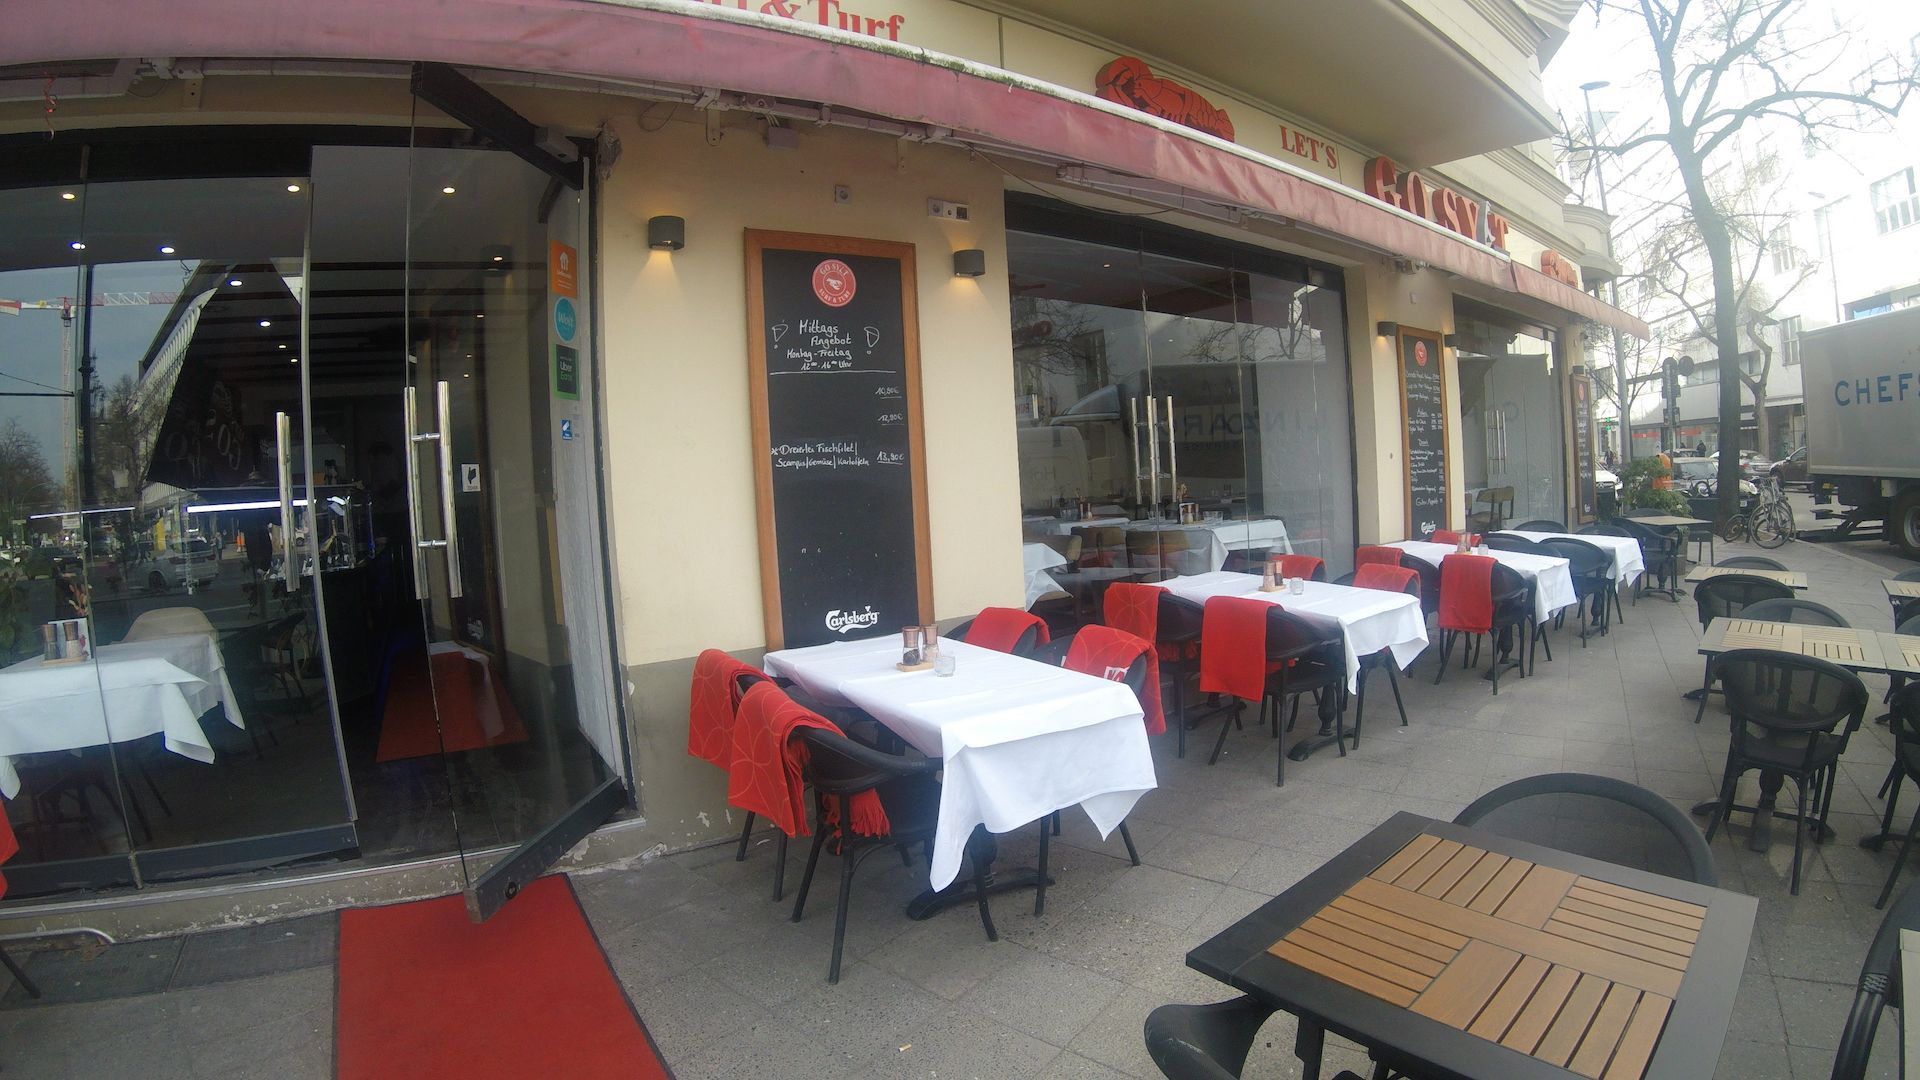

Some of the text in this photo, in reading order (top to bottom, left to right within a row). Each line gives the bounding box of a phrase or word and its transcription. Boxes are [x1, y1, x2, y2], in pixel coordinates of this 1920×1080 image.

[806, 0, 906, 42] Turf
[1279, 124, 1337, 169] LET'S
[1364, 155, 1428, 220] GO
[799, 319, 839, 338] Mittags
[810, 332, 852, 350] Angebot
[838, 360, 853, 369] Uhr
[1834, 372, 1920, 407] CHEF
[825, 605, 879, 633] Carlsberg
